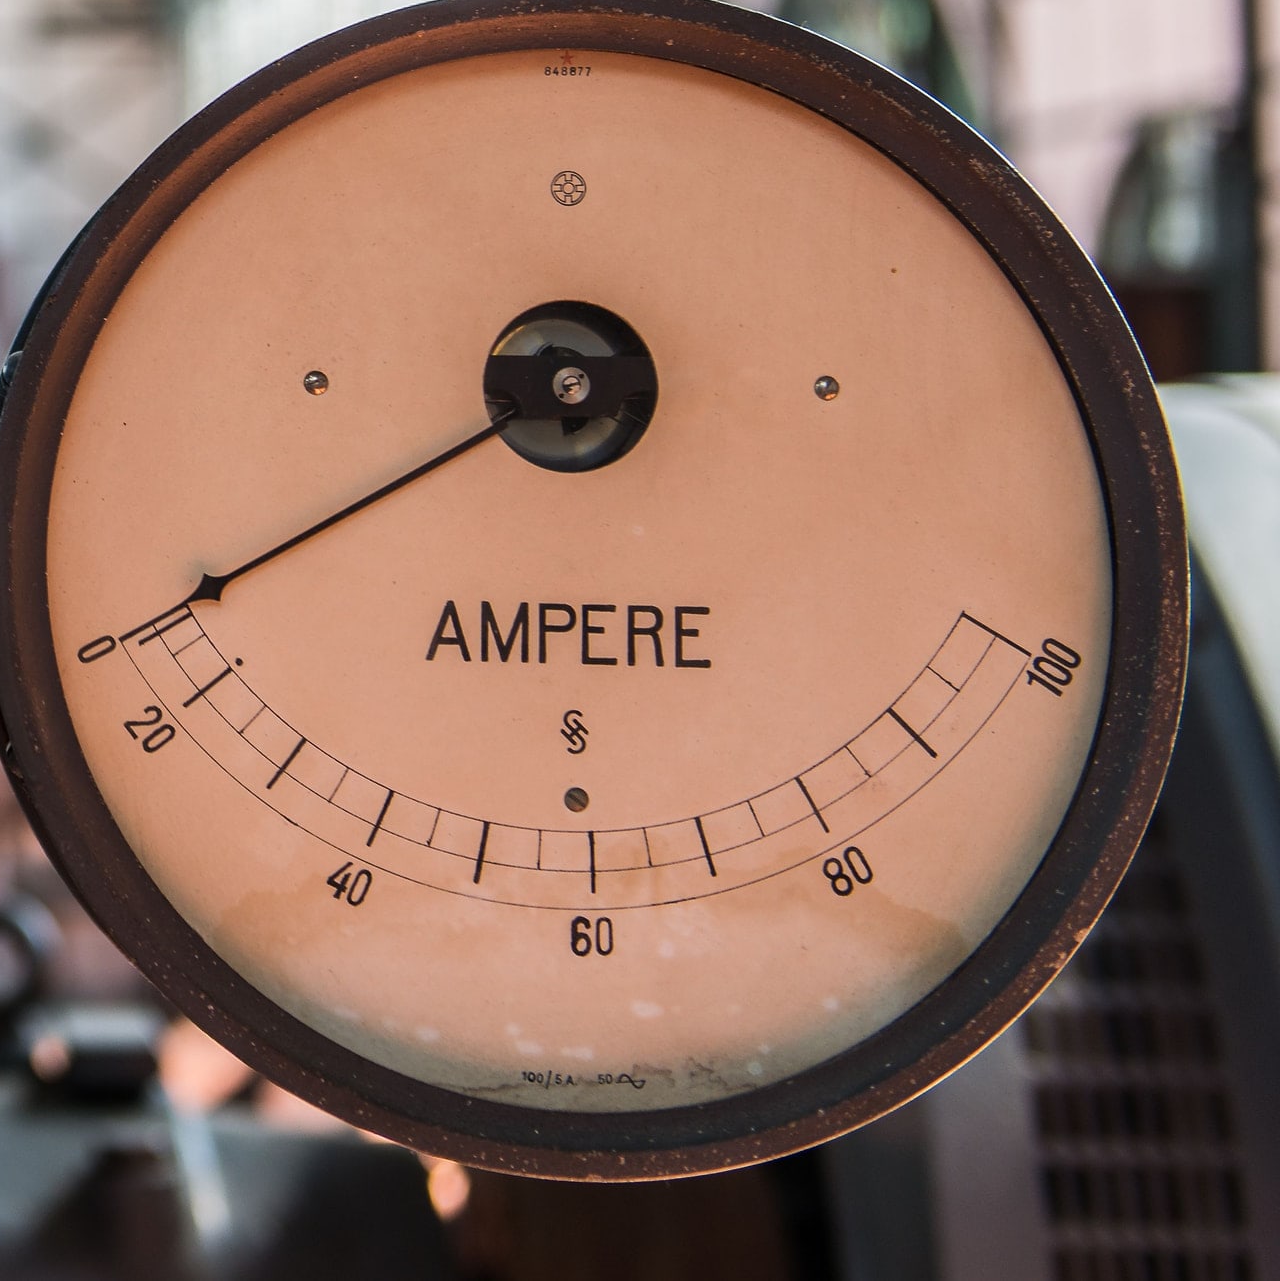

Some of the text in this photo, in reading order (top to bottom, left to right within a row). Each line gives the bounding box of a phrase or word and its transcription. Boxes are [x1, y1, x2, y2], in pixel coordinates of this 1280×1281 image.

[545, 66, 591, 76] 848877
[77, 635, 117, 664] 0
[426, 600, 711, 668] AMPERE
[1024, 637, 1082, 697] 100
[123, 705, 177, 754] 20
[327, 862, 372, 906] 40
[823, 846, 873, 896] 80
[571, 916, 613, 956] 60
[598, 1074, 613, 1084] 50
